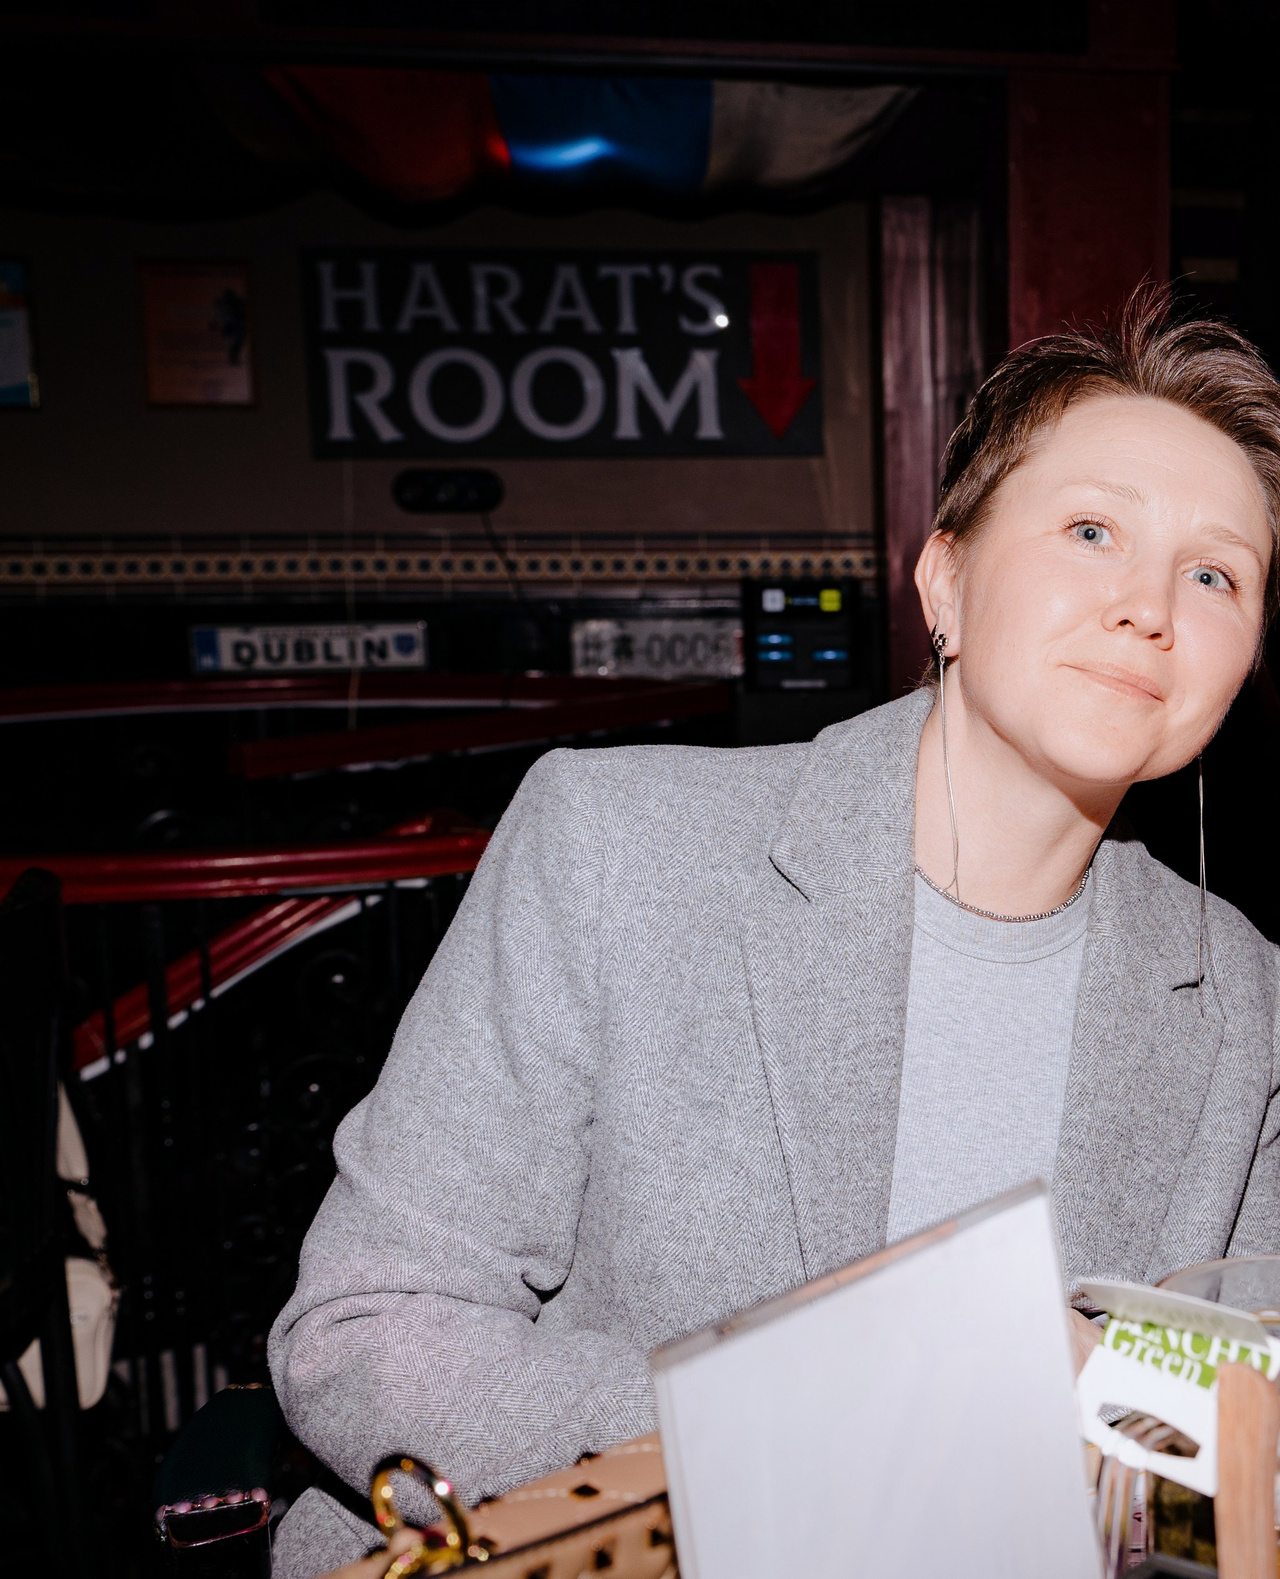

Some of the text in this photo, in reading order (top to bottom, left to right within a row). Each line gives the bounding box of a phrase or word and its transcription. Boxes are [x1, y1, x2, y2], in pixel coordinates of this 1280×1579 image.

[315, 260, 728, 336] HARAT'S
[322, 344, 726, 445] ROOM
[233, 637, 388, 666] DUBLIN
